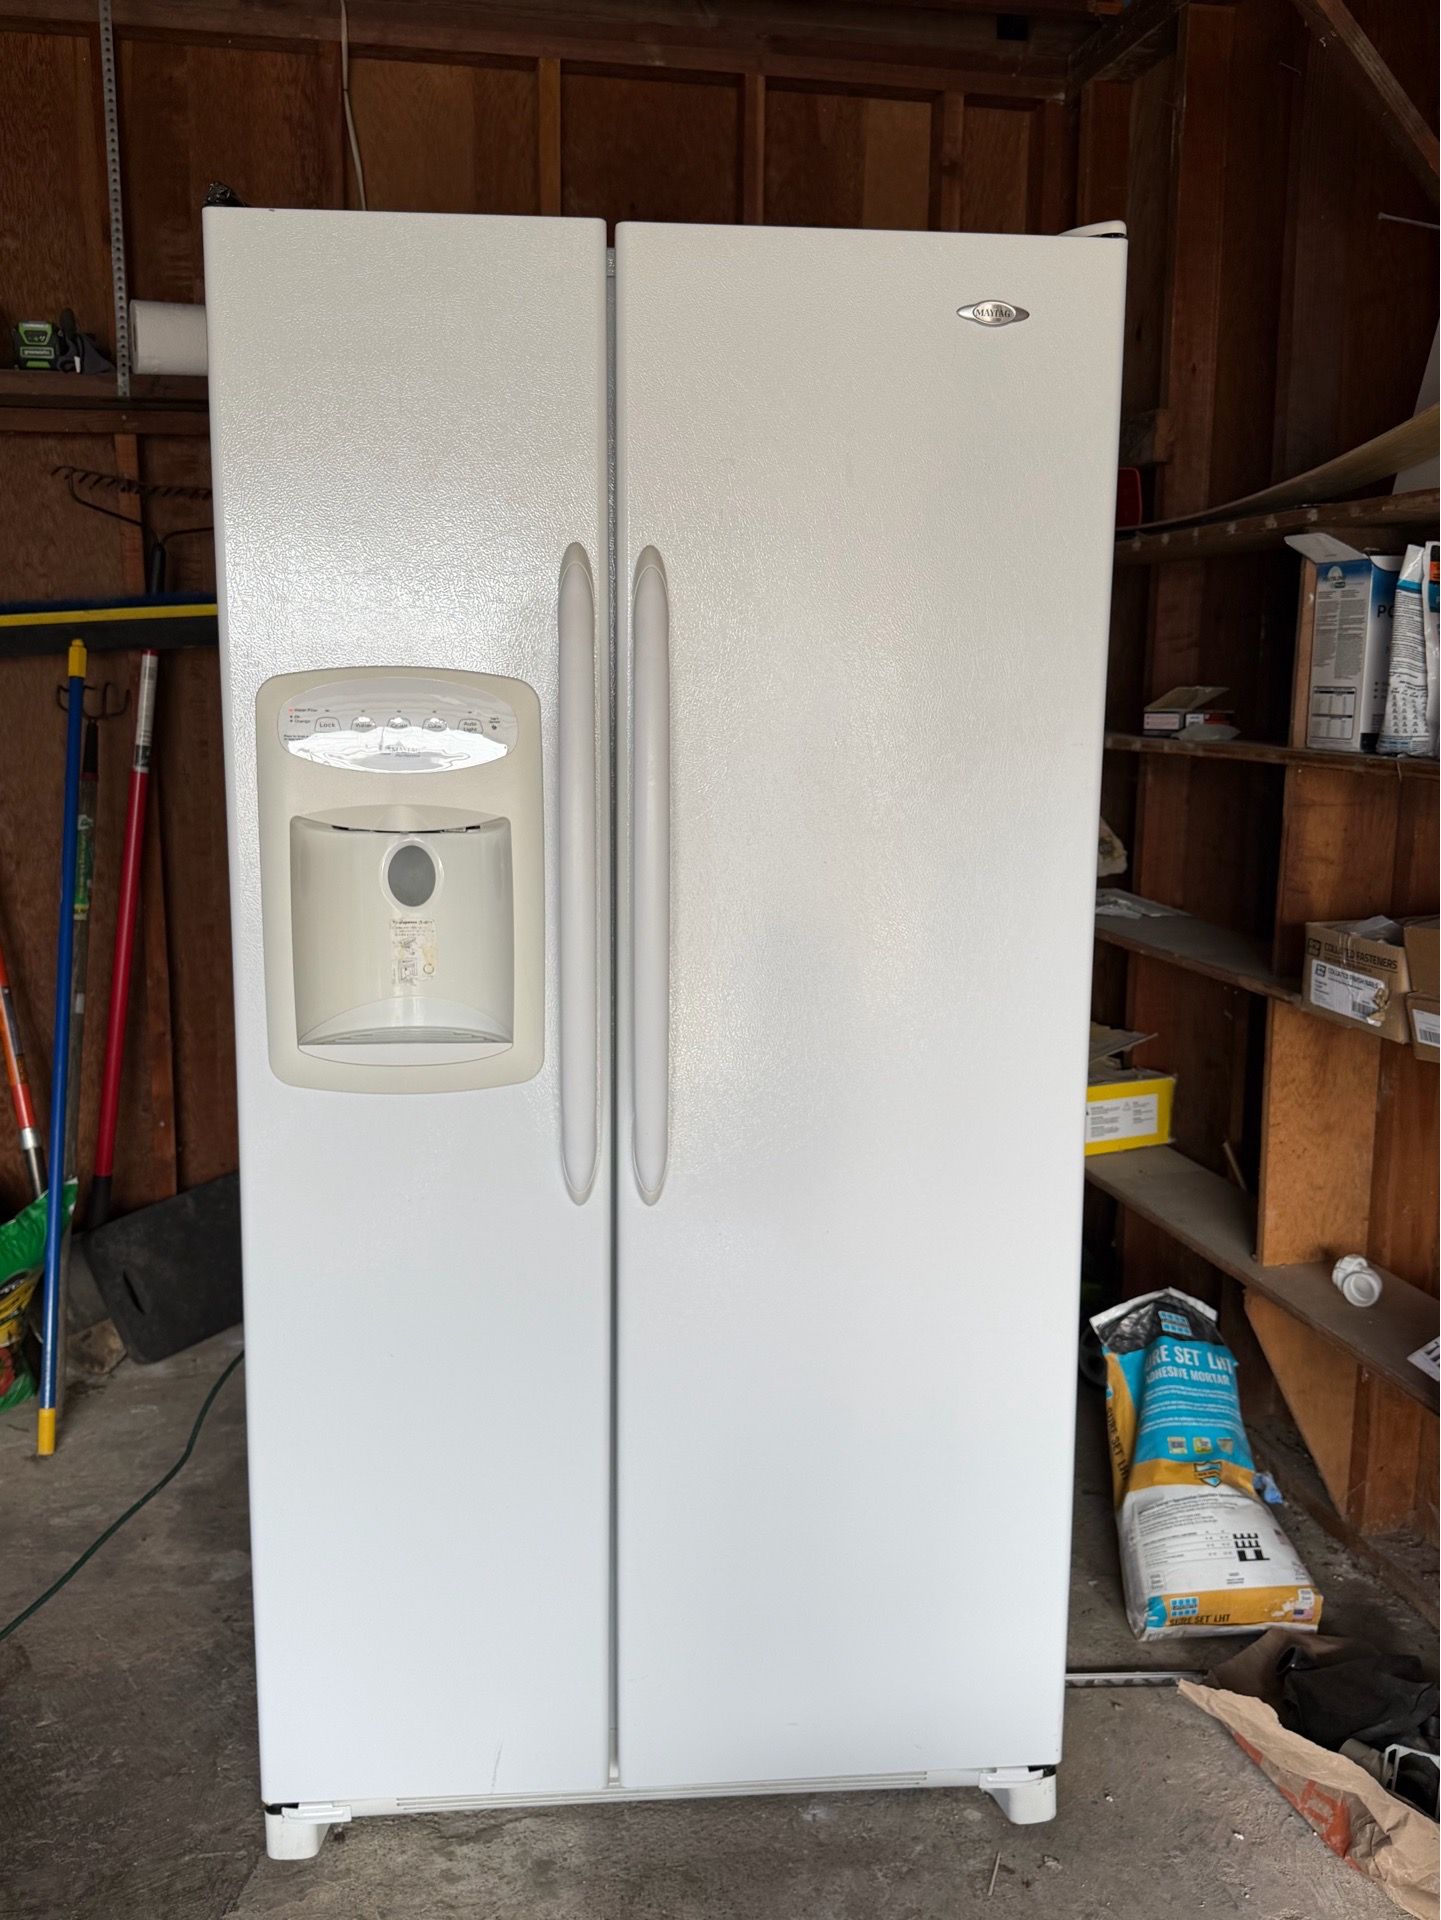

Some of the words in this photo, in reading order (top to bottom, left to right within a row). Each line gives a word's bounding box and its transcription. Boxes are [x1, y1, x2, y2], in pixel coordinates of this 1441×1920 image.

[976, 308, 1011, 318] MAYTAG
[1356, 950, 1398, 970] FASTENERS
[1173, 1345, 1202, 1367] SET
[1111, 1436, 1124, 1457] SET
[1194, 1615, 1211, 1625] SET
[1213, 1613, 1231, 1623] LHT
